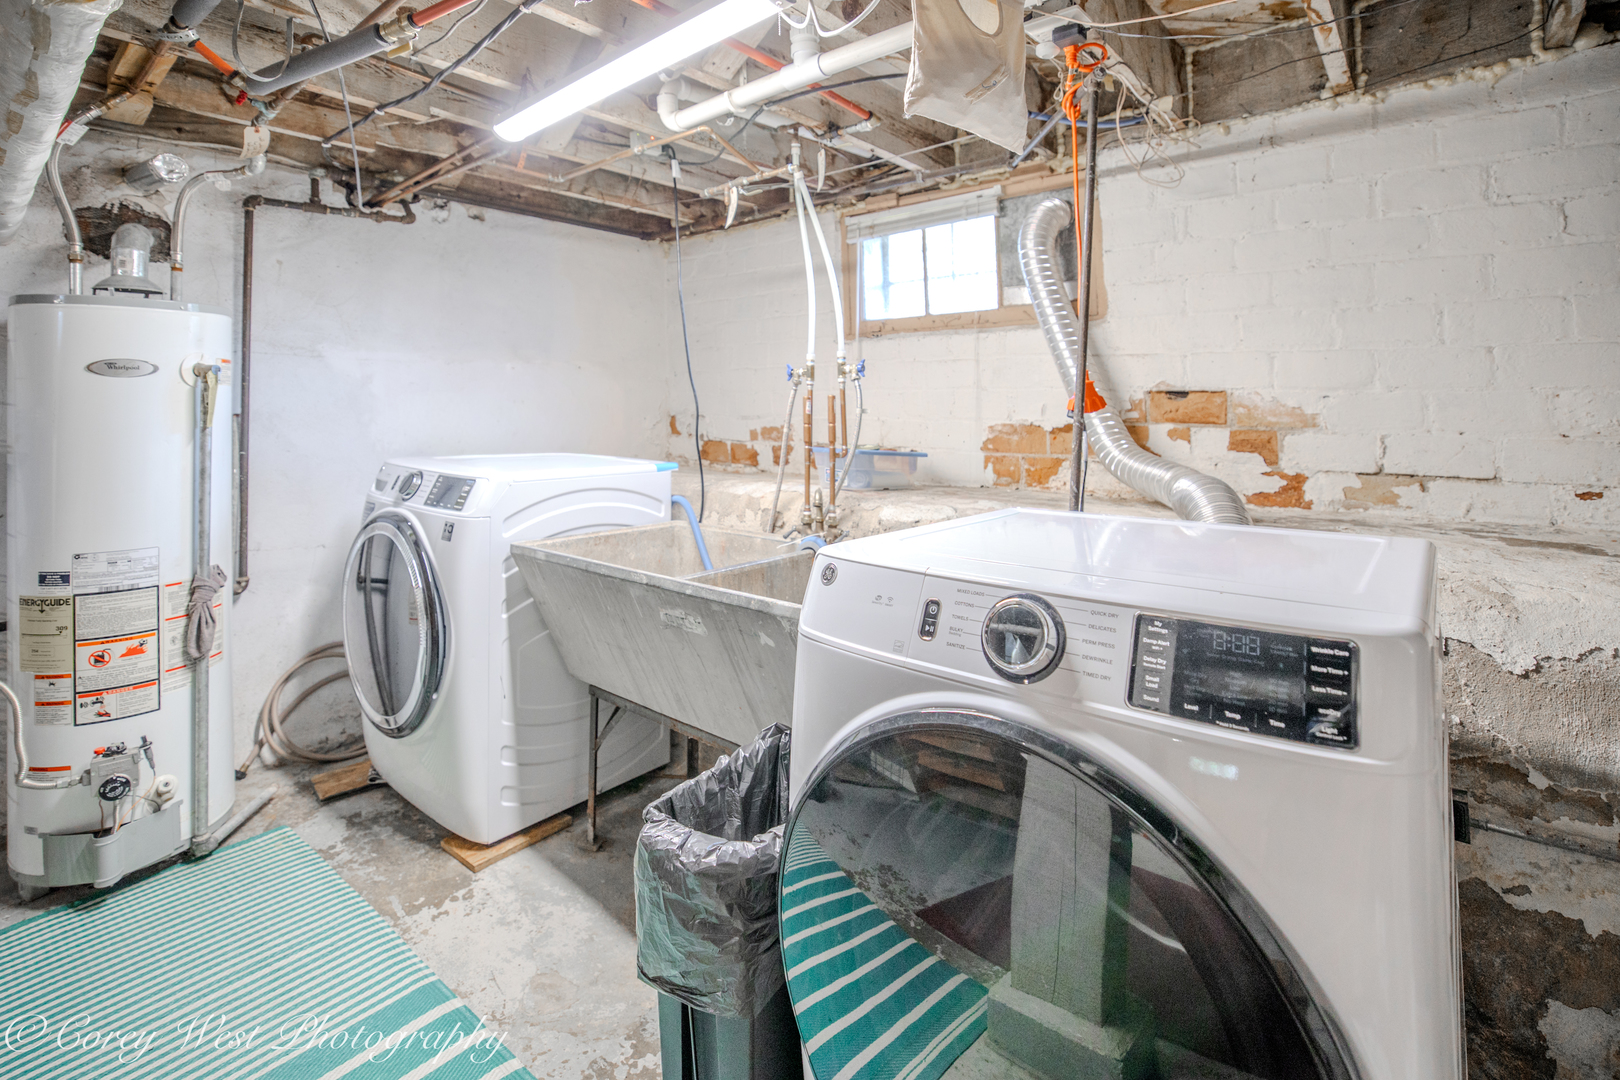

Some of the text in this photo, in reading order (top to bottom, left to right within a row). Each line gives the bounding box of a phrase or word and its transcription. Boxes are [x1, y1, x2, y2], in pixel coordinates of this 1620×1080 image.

[106, 364, 140, 372] Whirlpool
[1088, 624, 1117, 633] DELICATES
[1148, 626, 1168, 634] Settings
[1098, 641, 1115, 649] PRESS
[1142, 637, 1158, 645] Damp
[946, 642, 965, 650] SANITIZE
[1310, 646, 1349, 657] Wrinkle Care
[1082, 654, 1113, 665] DEWRINKLE
[1143, 655, 1157, 663] Delay
[1310, 665, 1327, 673] More
[1327, 667, 1343, 675] Time
[1311, 685, 1326, 693] Less
[1326, 687, 1343, 696] Time
[1143, 694, 1159, 702] Sound
[1184, 703, 1199, 711] Level
[1224, 710, 1241, 720] Temp
[1269, 719, 1285, 728] Time
[1321, 726, 1338, 735] Light
